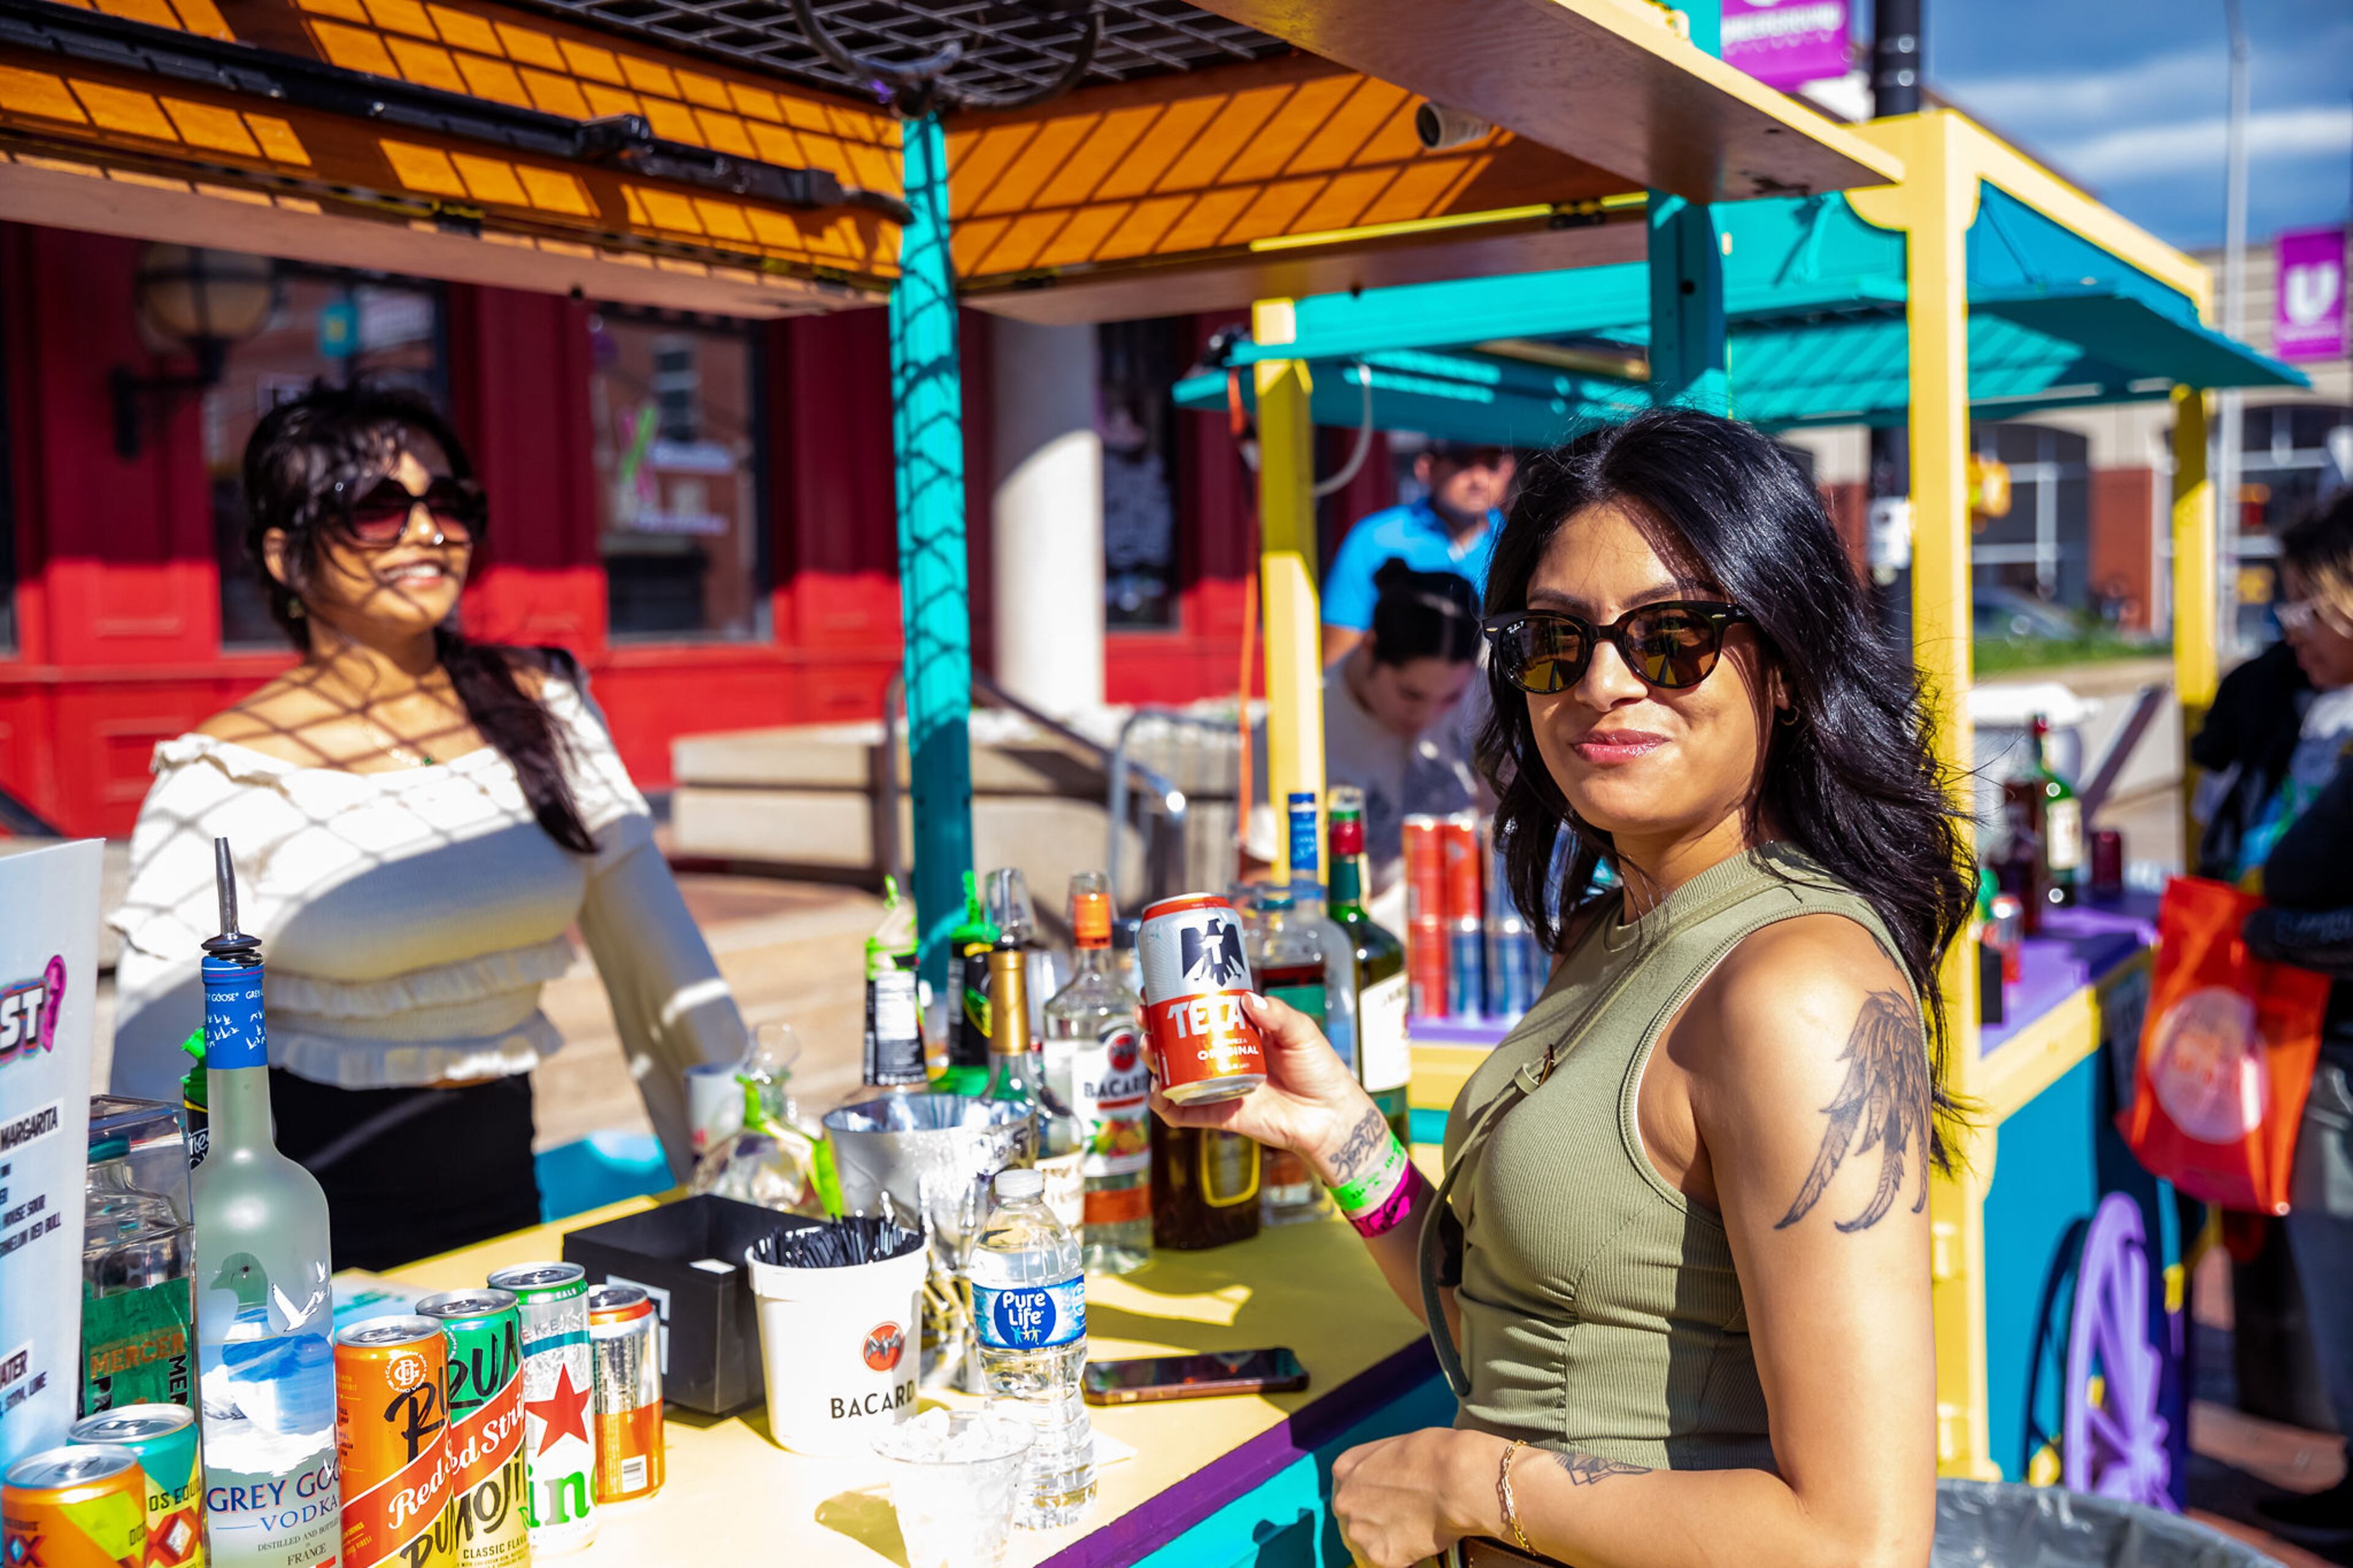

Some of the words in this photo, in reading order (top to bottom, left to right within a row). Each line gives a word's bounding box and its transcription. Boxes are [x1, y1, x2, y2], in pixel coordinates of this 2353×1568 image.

[1002, 1291, 1046, 1309] Pure
[1009, 1308, 1042, 1330] Life
[90, 1332, 186, 1379] MERCER
[830, 1379, 915, 1419] BACARD
[207, 1479, 288, 1515] GREY
[295, 1457, 339, 1498] GOO
[259, 1494, 338, 1532] VODKA
[287, 1542, 327, 1566] FRANCE
[463, 1543, 506, 1559] CLASSIC
